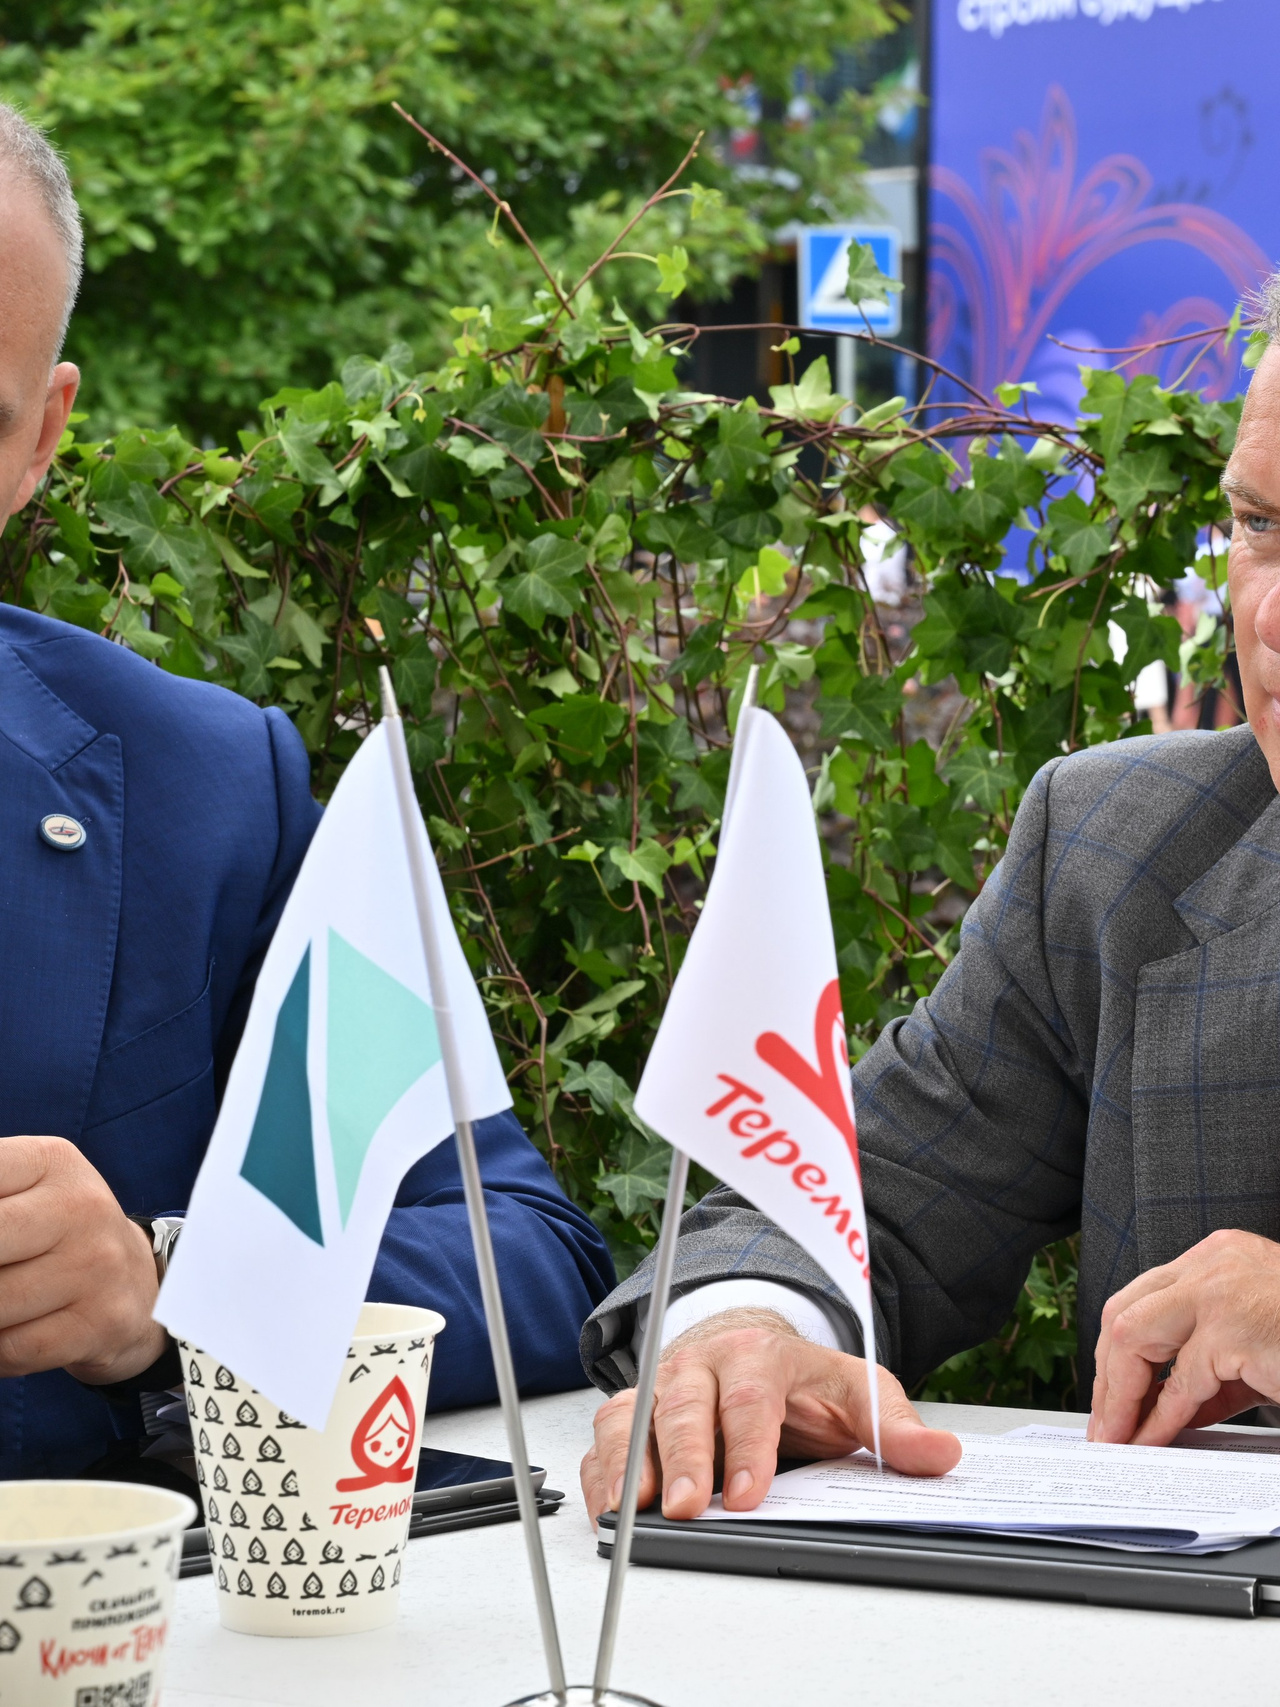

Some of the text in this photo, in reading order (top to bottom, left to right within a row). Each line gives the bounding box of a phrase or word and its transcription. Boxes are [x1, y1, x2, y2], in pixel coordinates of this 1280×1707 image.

[705, 1073, 871, 1279] Теремо
[329, 1494, 412, 1530] Теремок
[292, 1606, 346, 1616] teremok.ru
